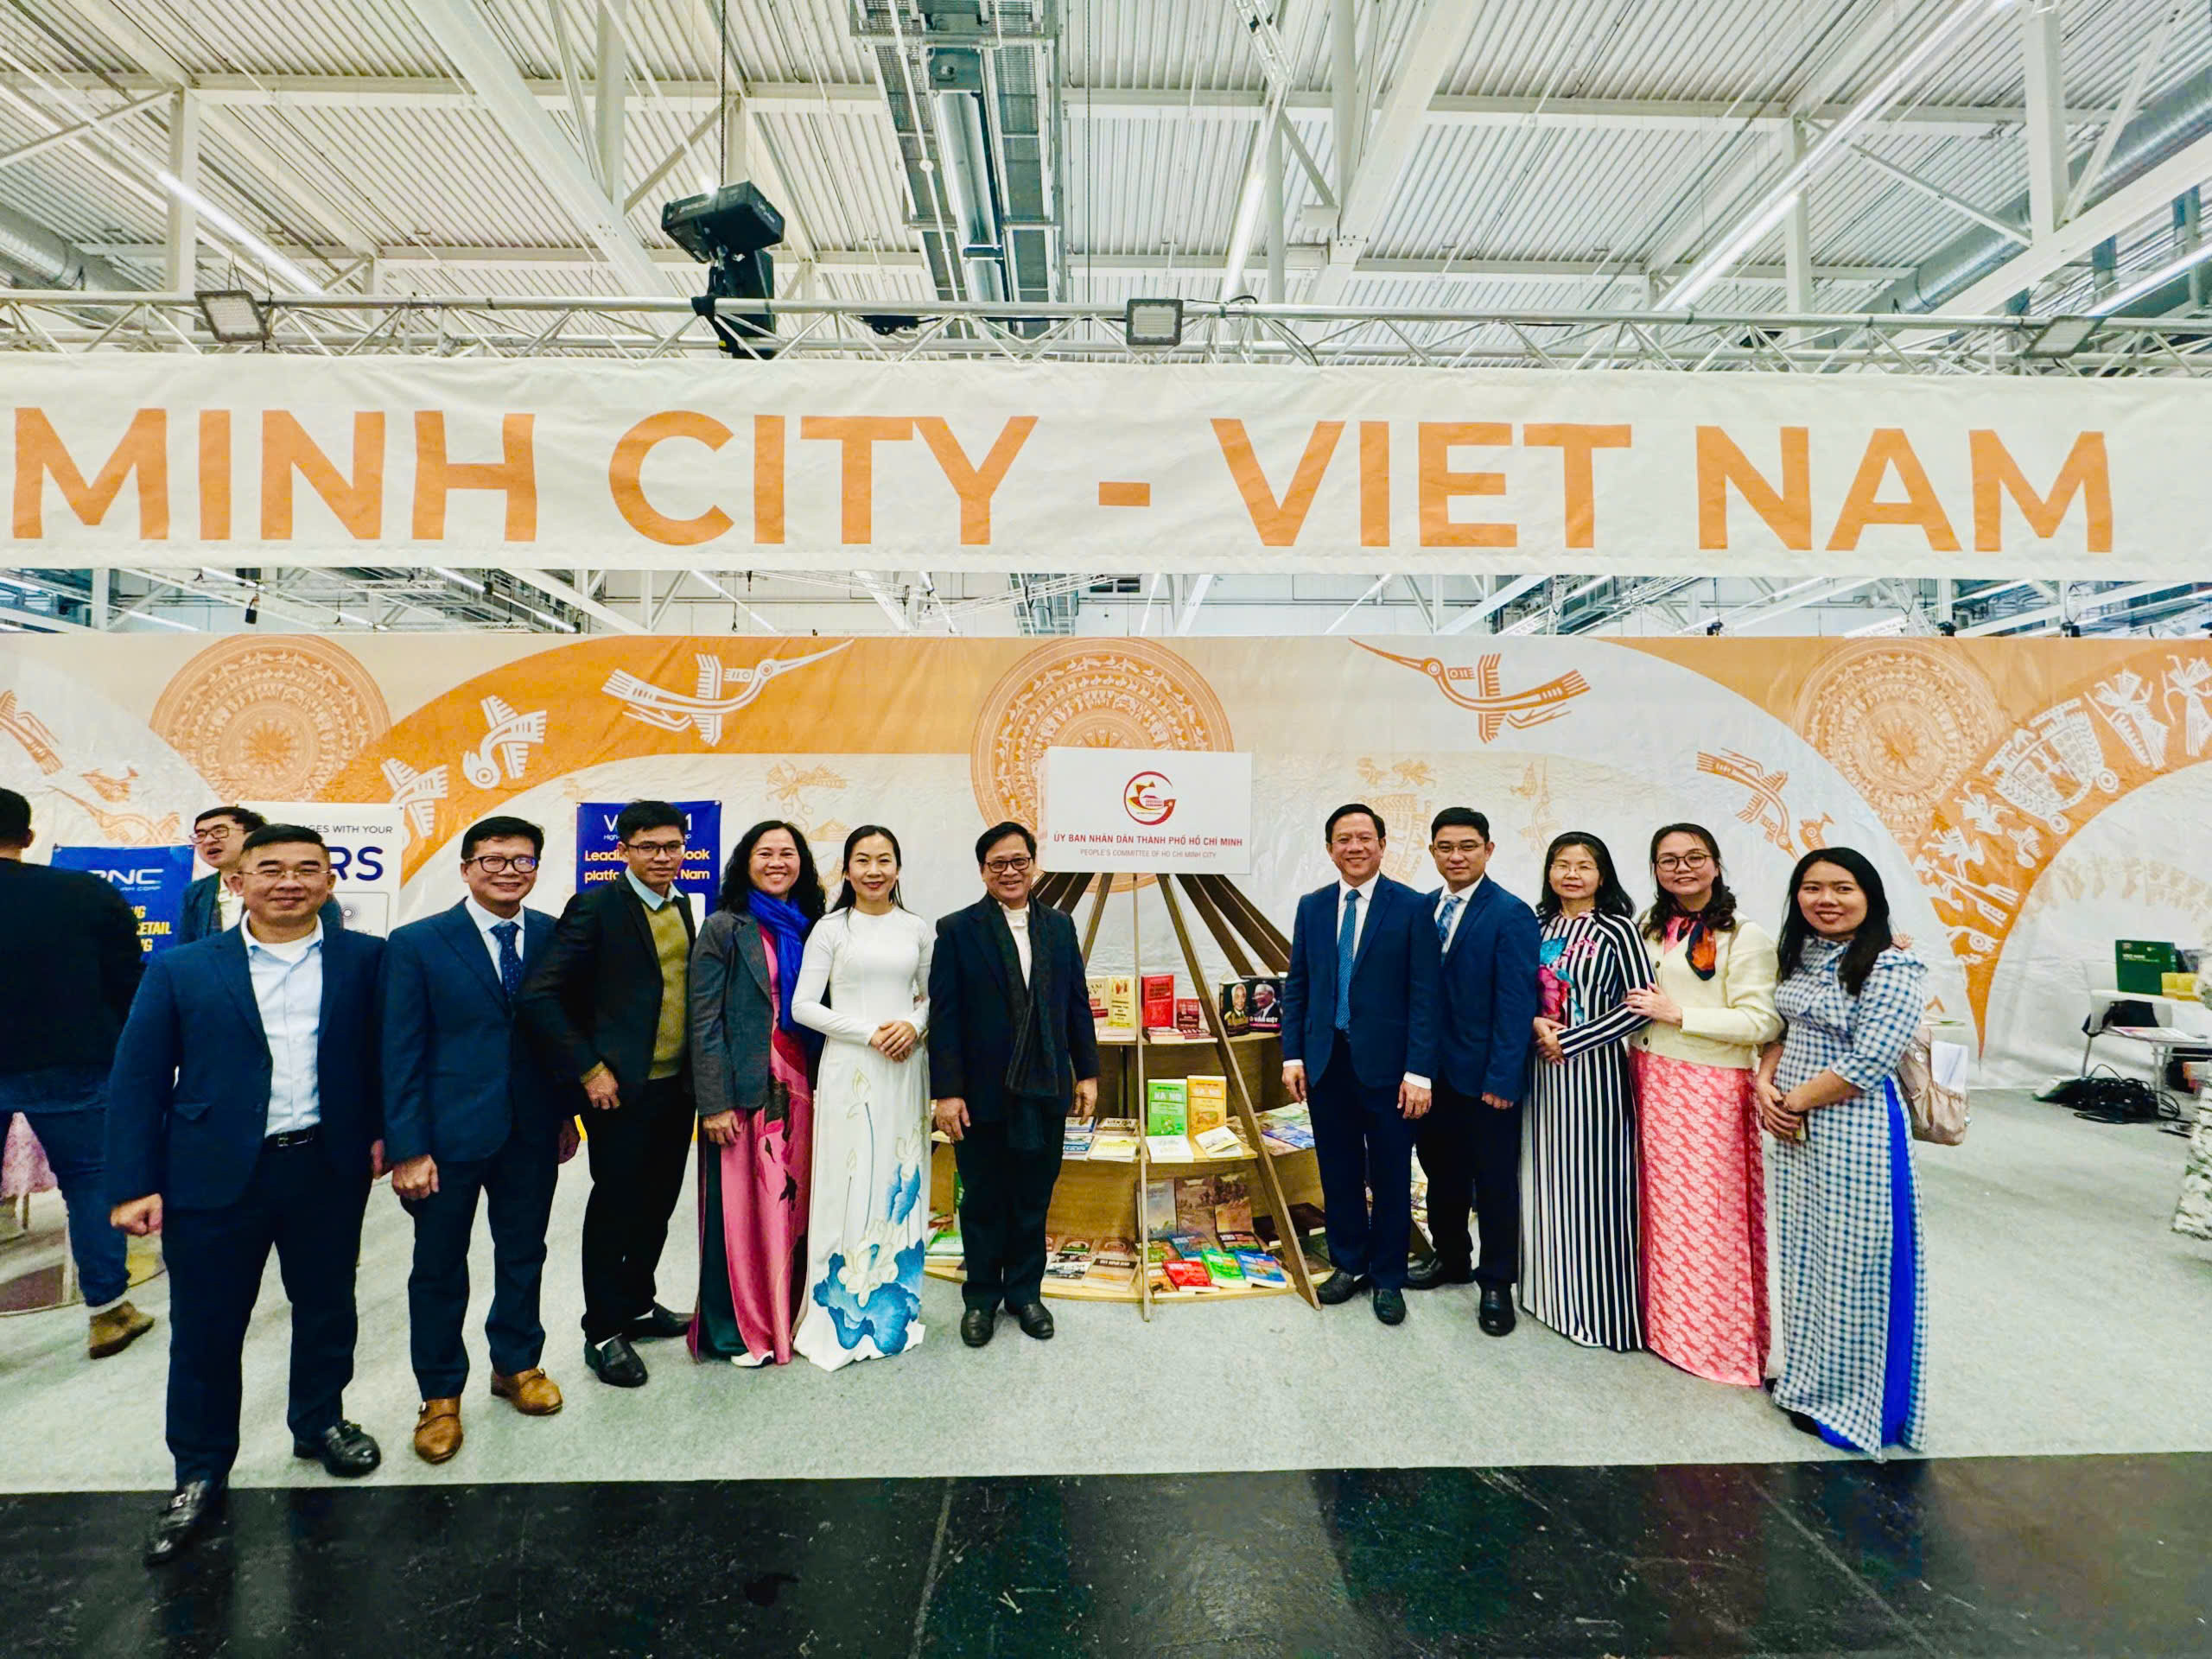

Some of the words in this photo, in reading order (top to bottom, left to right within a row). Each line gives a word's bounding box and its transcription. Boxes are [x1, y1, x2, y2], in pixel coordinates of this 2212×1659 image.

[13, 407, 537, 542] MINH
[608, 410, 1037, 546] CITY
[1099, 481, 1150, 506] -
[1211, 418, 1631, 549] VIET
[1696, 425, 2113, 553] NAM
[332, 825, 359, 834] WITH
[362, 825, 393, 834] YOUR
[1068, 834, 1086, 842] BAN
[1220, 837, 1243, 847] MINH
[680, 868, 711, 880] Nam
